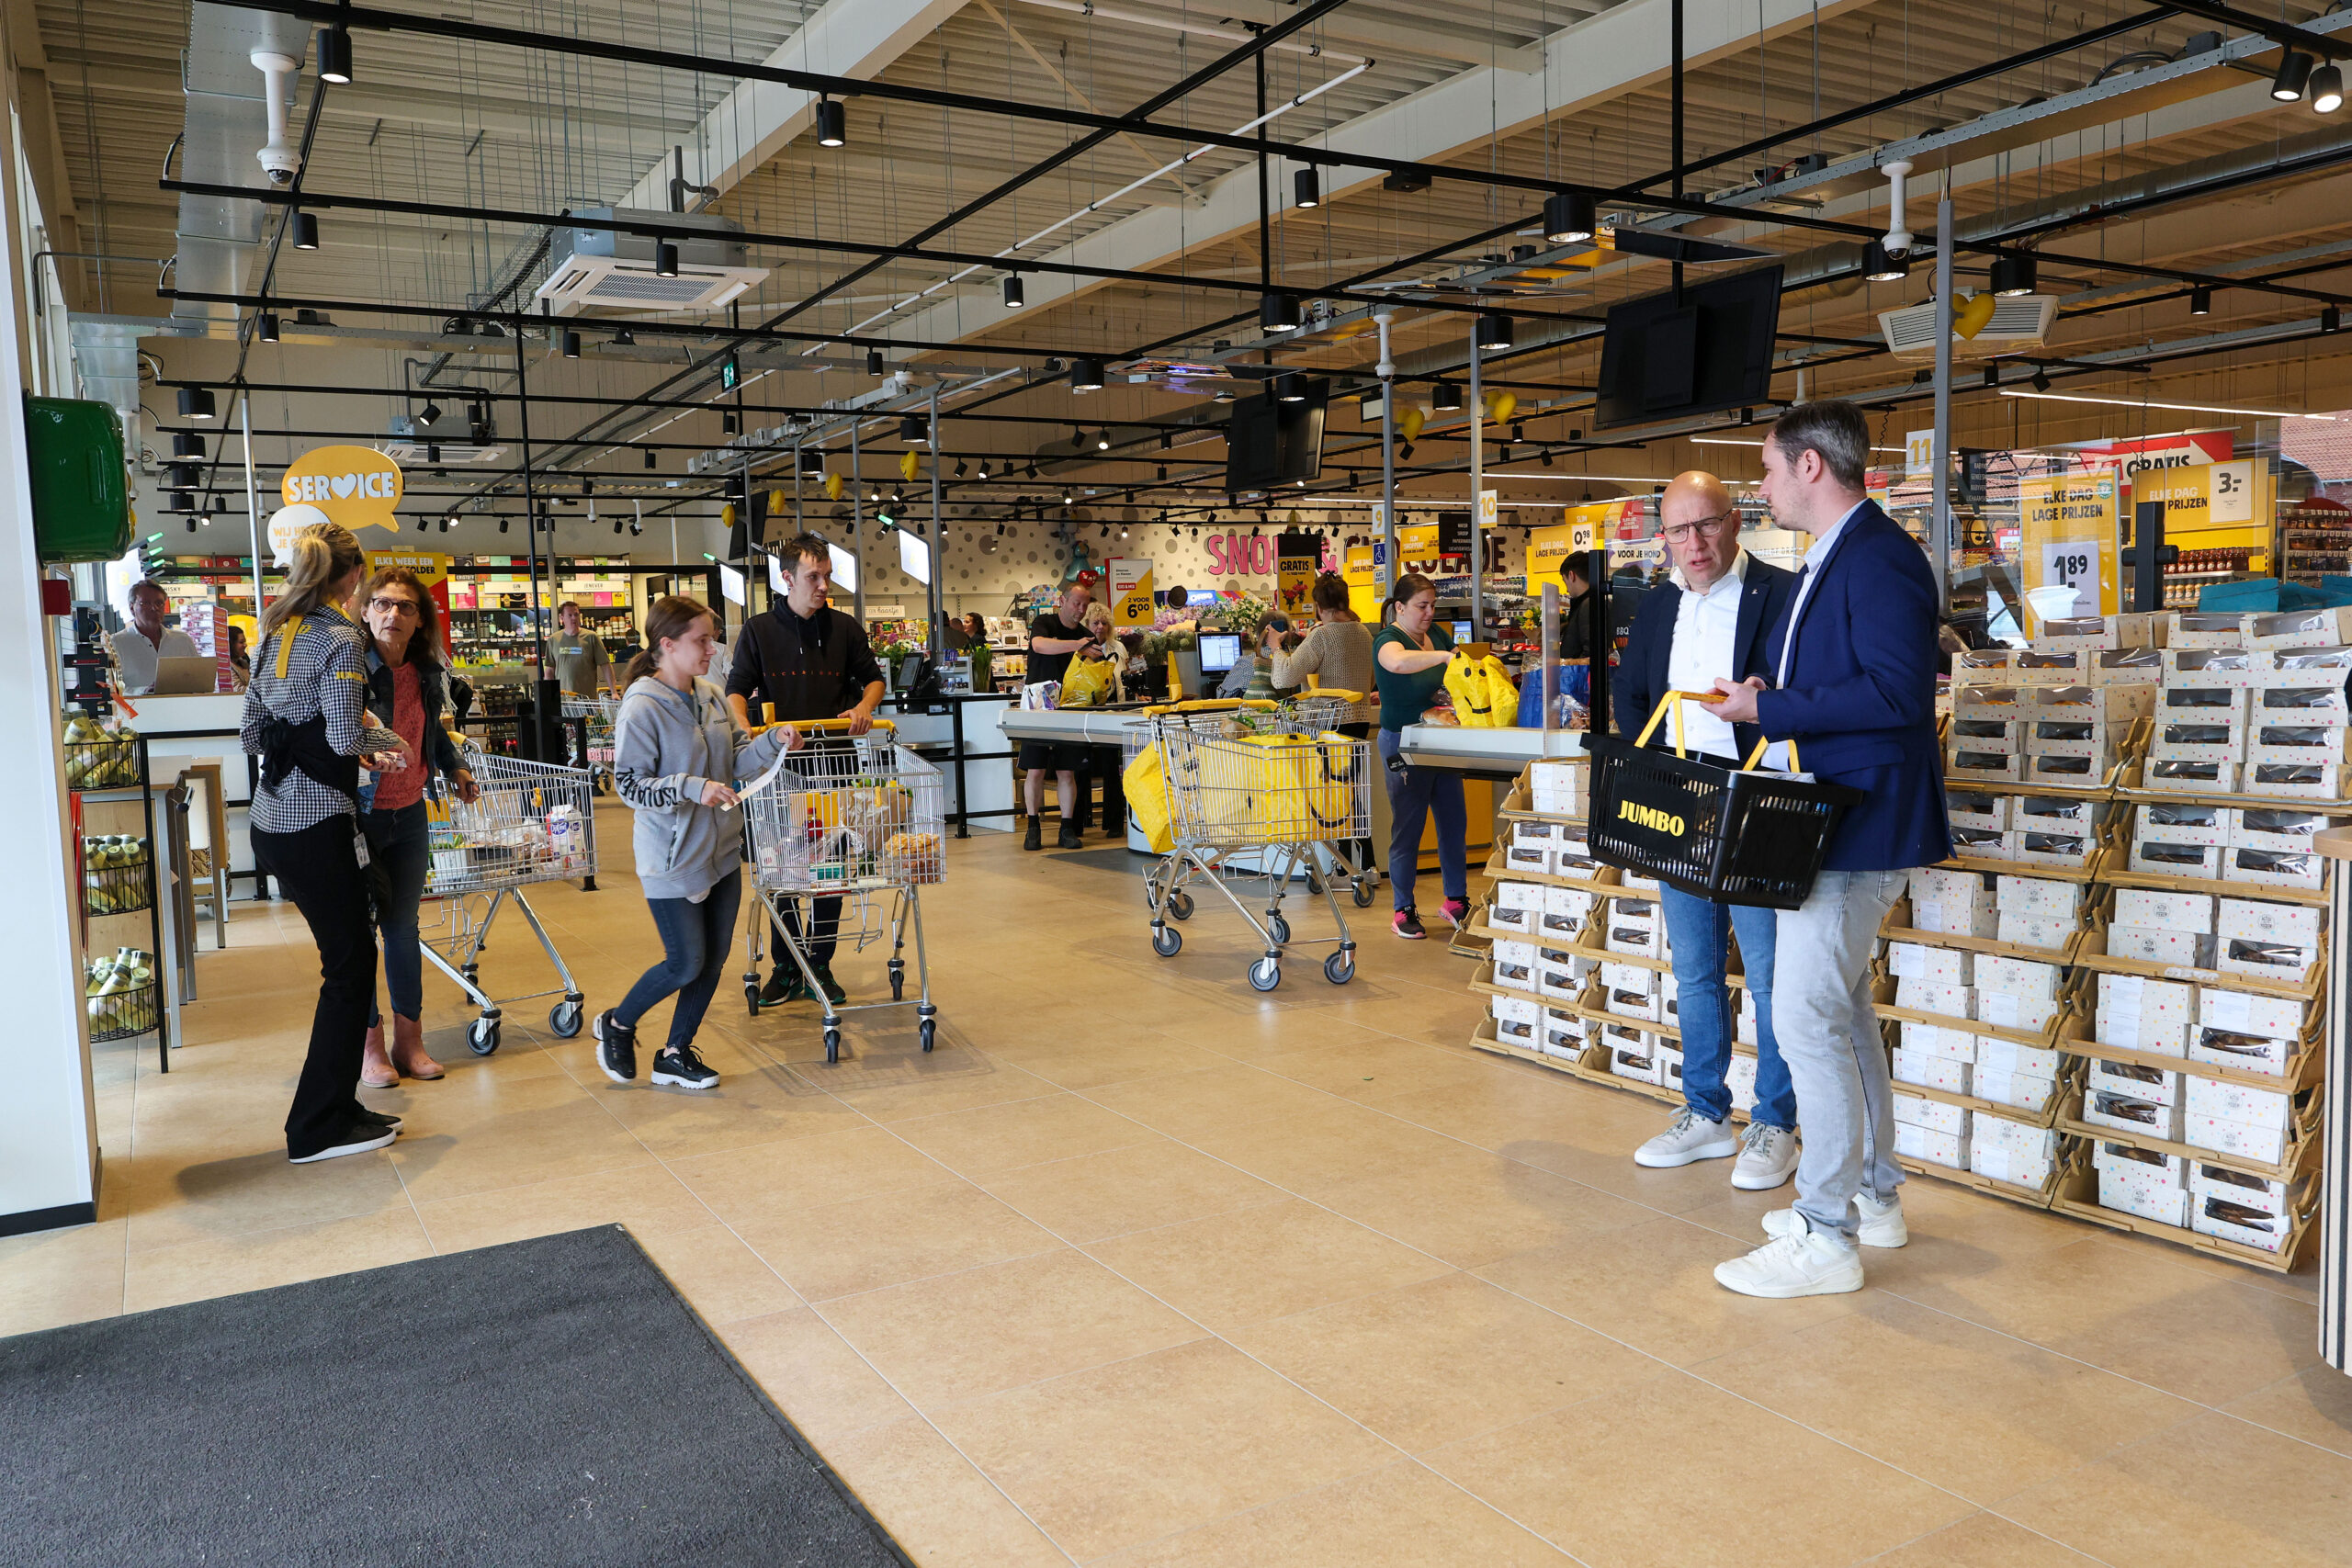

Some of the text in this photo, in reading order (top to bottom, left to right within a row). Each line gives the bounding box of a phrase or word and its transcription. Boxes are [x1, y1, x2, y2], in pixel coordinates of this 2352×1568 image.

[1909, 438, 1931, 466] 11
[2043, 490, 2065, 503] ELKE
[2069, 488, 2093, 502] DAG
[2175, 487, 2199, 499] DAG
[1480, 496, 1497, 517] 10
[2168, 497, 2208, 511] PRIJZEN
[2032, 504, 2103, 522] LAGE PRIJZEN
[1375, 510, 1383, 529] 9
[273, 526, 291, 537] WIJ
[277, 538, 288, 549] JE
[1208, 535, 1278, 575] SNO
[1535, 547, 1569, 558] LAGE PRIJZEN
[1617, 550, 1661, 558] VOOR JE HOND
[375, 557, 393, 565] ELKE
[395, 557, 417, 565] WEEK
[1280, 560, 1309, 571] GRATIS
[877, 607, 899, 615] kaartje
[1616, 626, 1629, 635] BBQ
[335, 671, 368, 683] JUM
[1617, 799, 1685, 837] JUMBO
